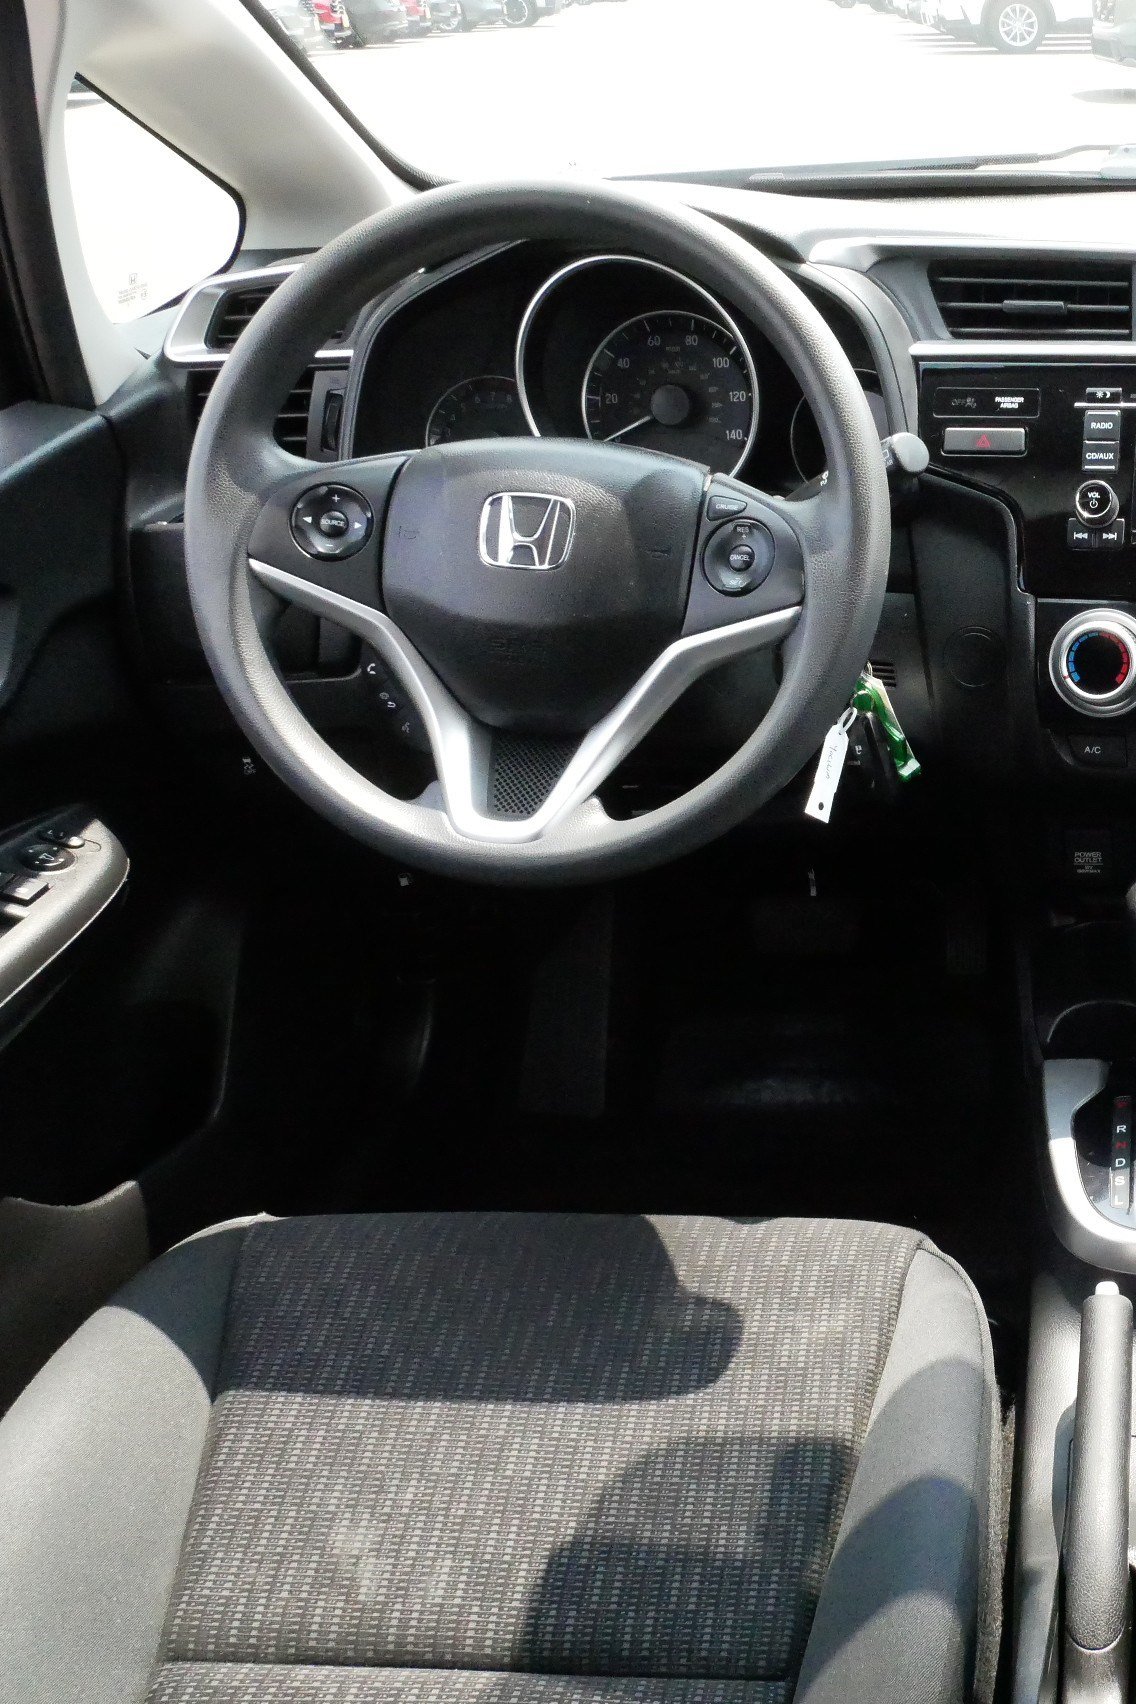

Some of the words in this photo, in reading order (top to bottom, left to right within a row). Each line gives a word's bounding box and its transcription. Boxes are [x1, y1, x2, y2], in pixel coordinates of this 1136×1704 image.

[647, 335, 661, 346] 60
[685, 335, 698, 346] 80
[617, 358, 630, 368] 40
[713, 357, 730, 368] 100
[605, 393, 618, 404] 20
[729, 391, 746, 401] 120
[1090, 421, 1114, 429] RADIO
[726, 429, 743, 440] 140
[1085, 452, 1114, 460] CD/AUX
[1087, 491, 1101, 499] VOL
[736, 525, 750, 533] RES
[1084, 746, 1101, 754] A/C
[1116, 1124, 1127, 1134] R
[1115, 1158, 1126, 1168] D
[1114, 1175, 1126, 1186] S
[1114, 1194, 1124, 1205] L
